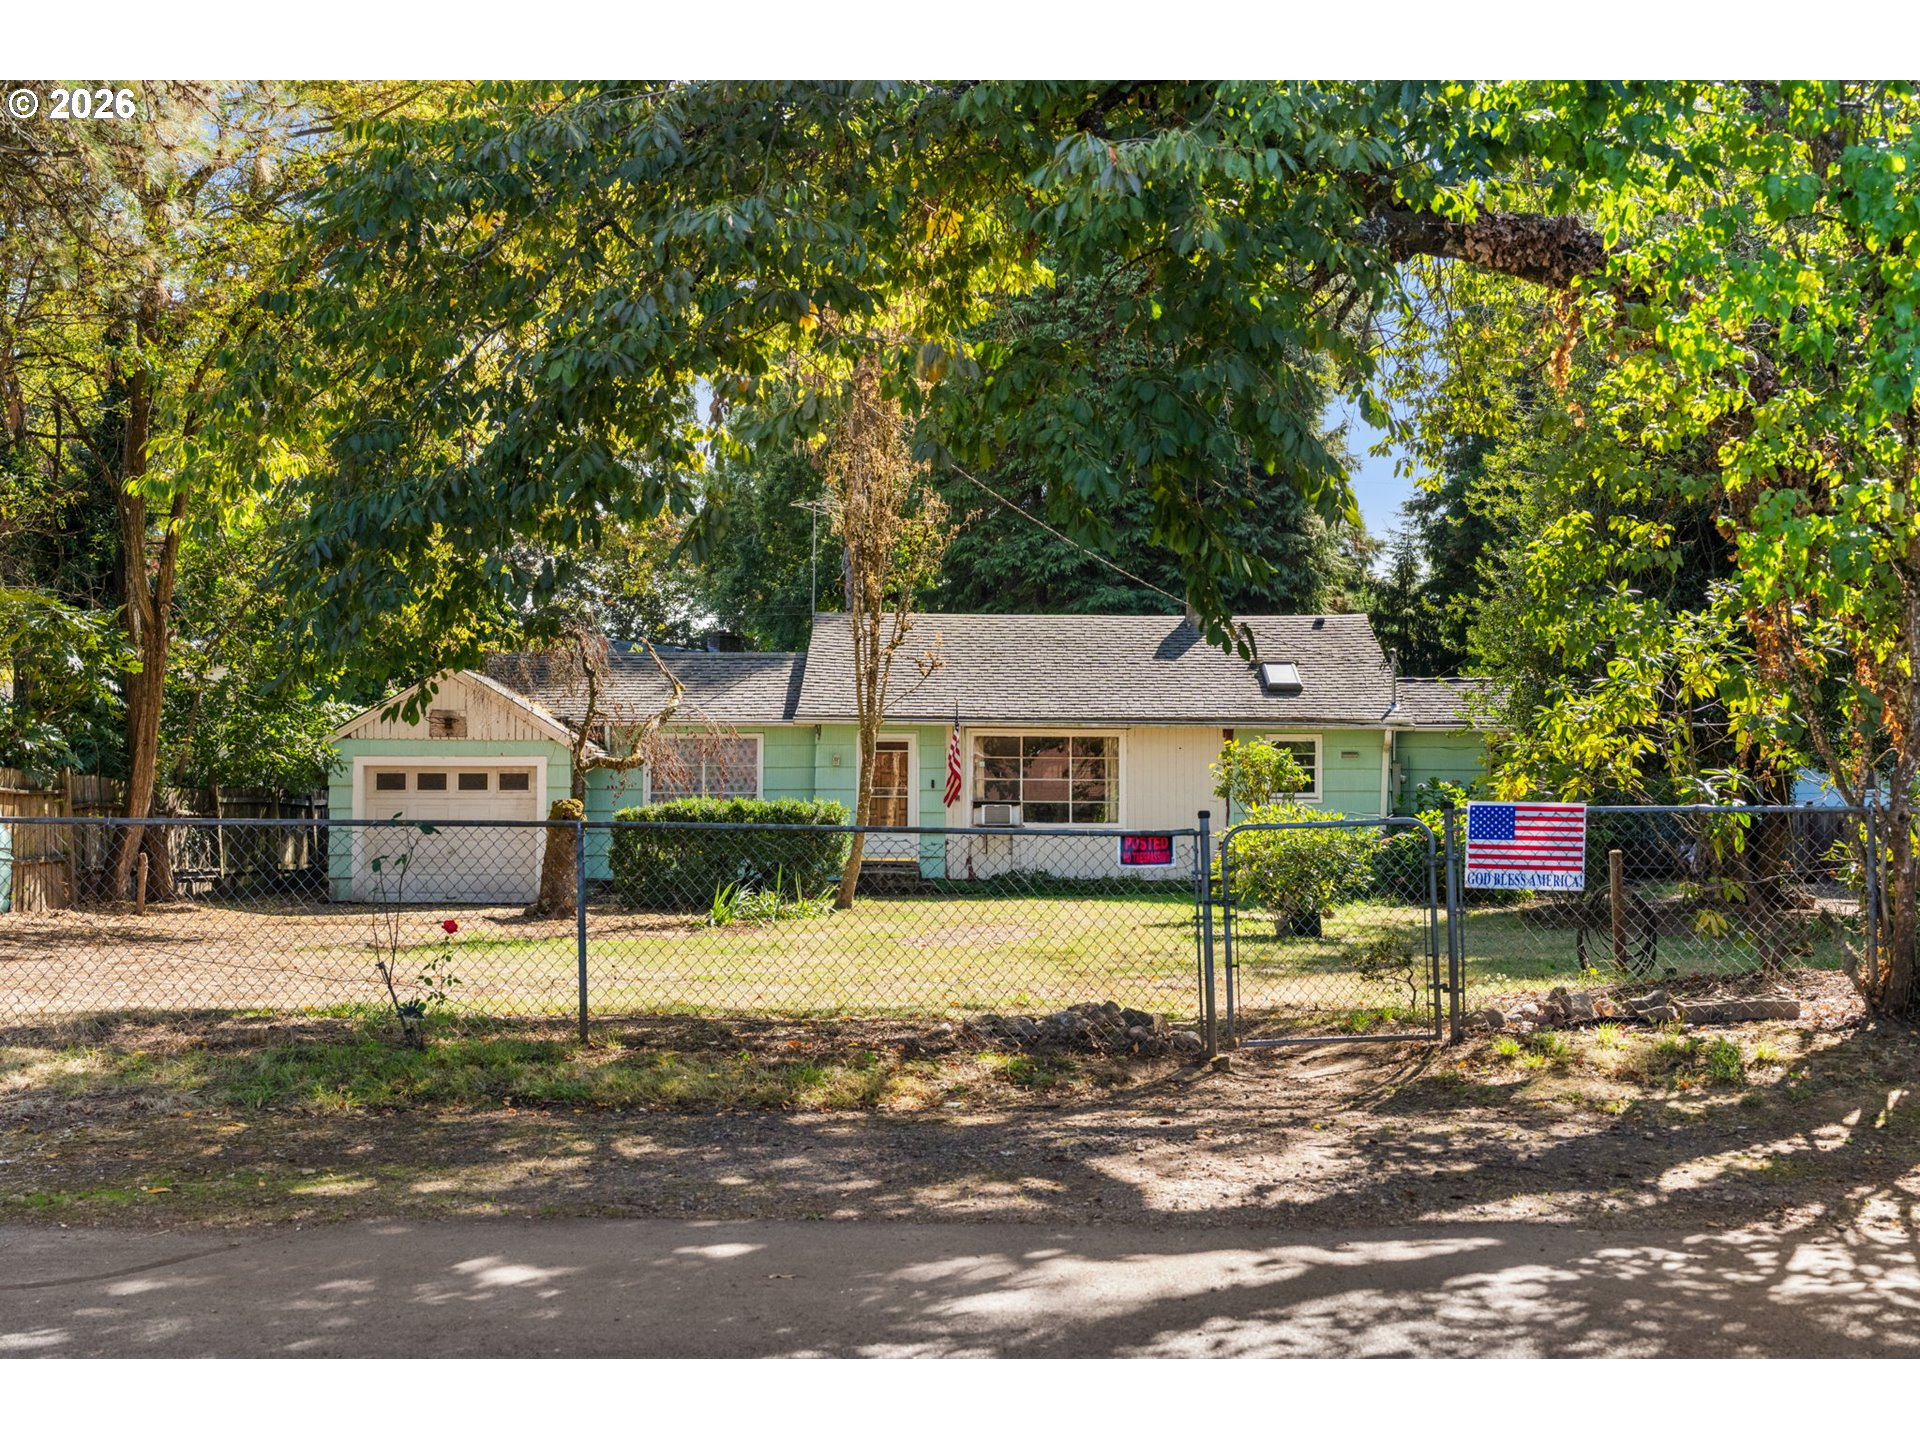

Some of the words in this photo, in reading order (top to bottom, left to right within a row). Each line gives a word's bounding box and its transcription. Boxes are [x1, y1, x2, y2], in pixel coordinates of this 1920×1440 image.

[1124, 836, 1169, 850] POSTED
[1467, 872, 1491, 885] GOD
[1494, 873, 1527, 886] BLESS
[1529, 874, 1583, 888] AMERICA!
